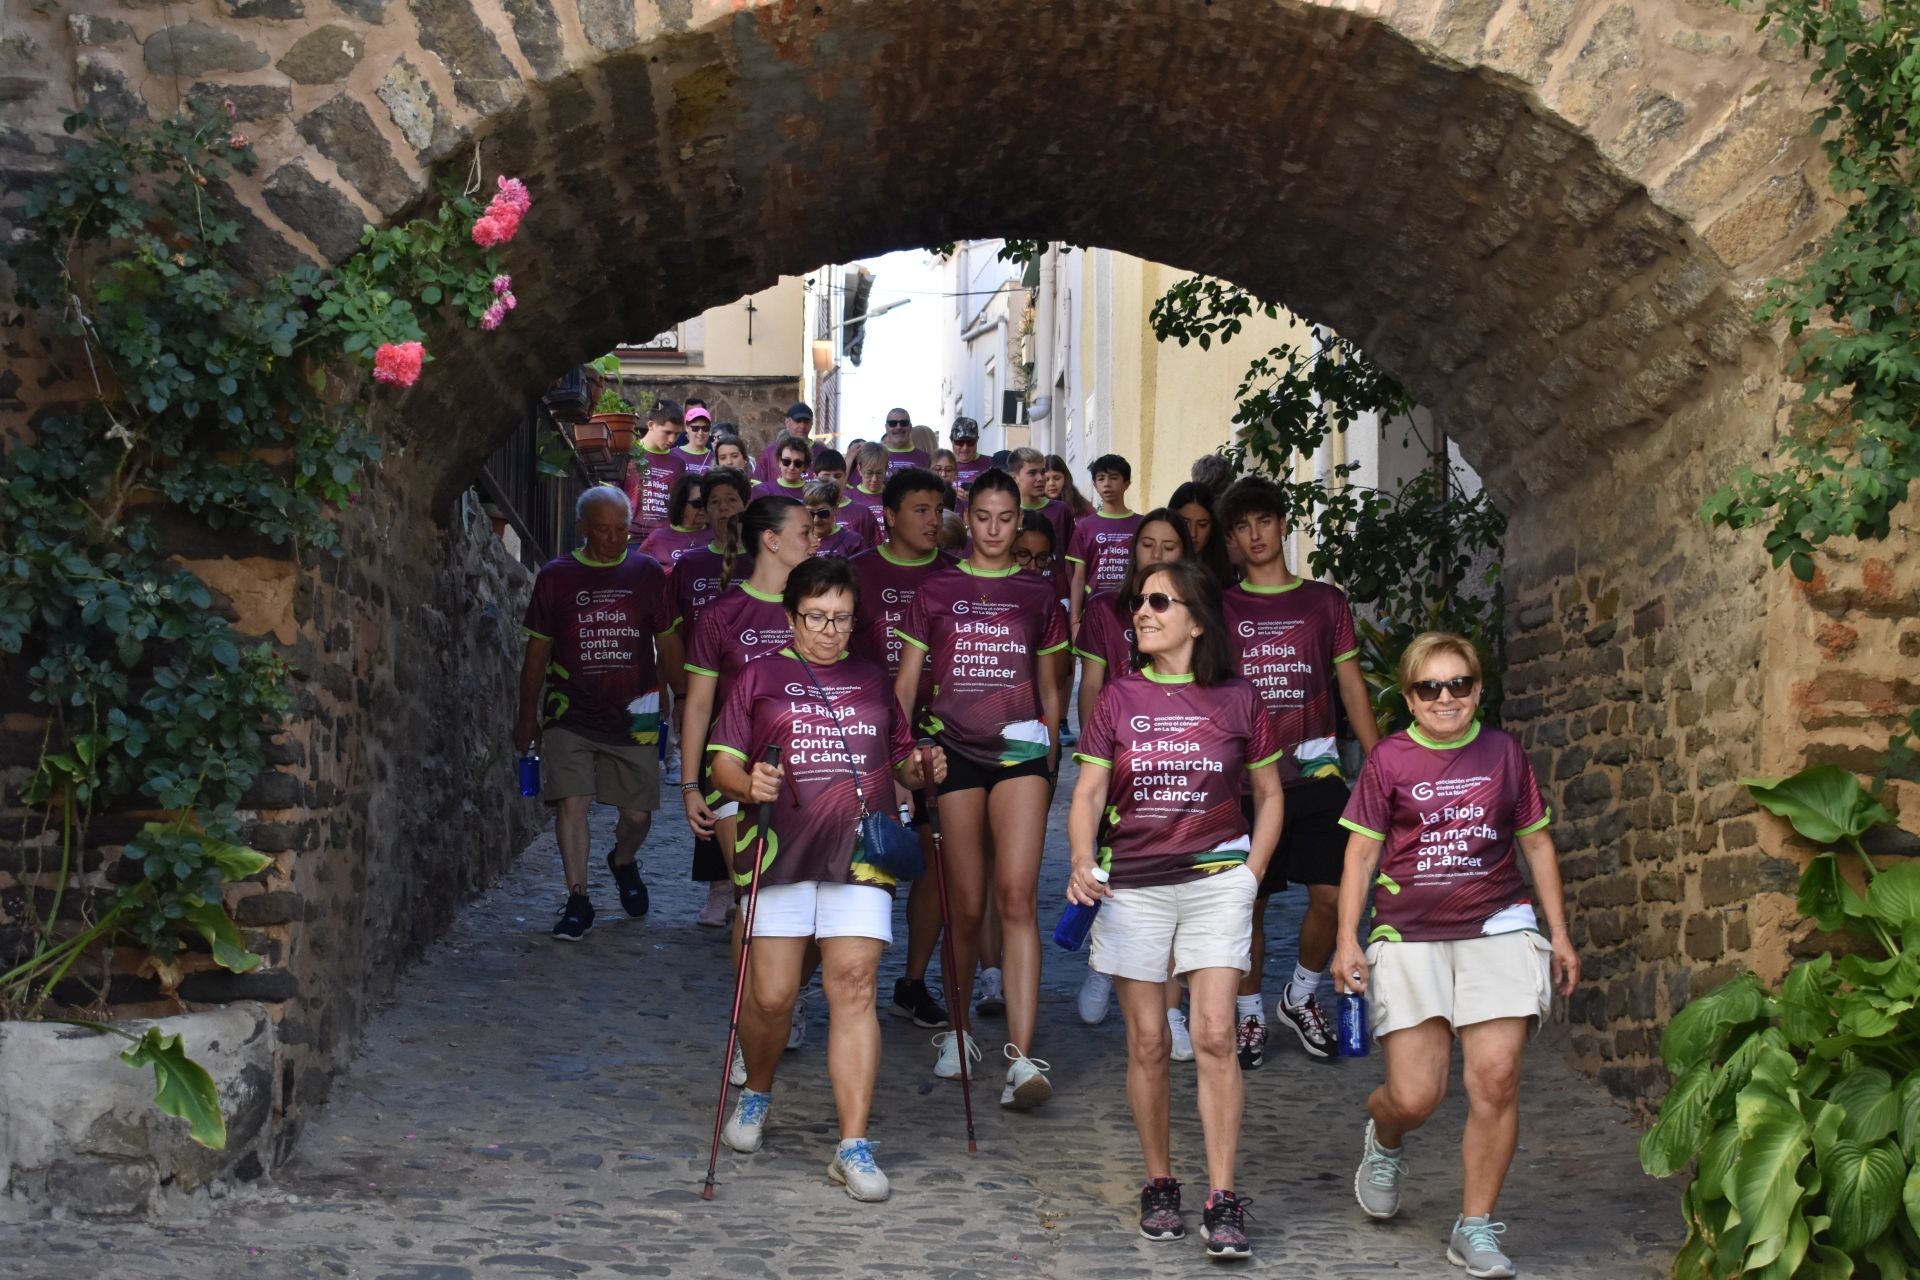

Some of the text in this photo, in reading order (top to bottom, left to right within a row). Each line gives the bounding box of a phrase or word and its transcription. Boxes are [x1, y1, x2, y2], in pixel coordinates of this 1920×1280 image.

[578, 610, 626, 623] La Rioja
[885, 610, 900, 621] La
[580, 627, 639, 638] En marcha
[955, 622, 1009, 637] La Rioja
[580, 638, 618, 649] contra
[955, 639, 1026, 654] En marcha
[581, 650, 632, 661] el cáncer
[887, 651, 899, 661] el
[1243, 644, 1296, 658] La Rioja
[954, 653, 998, 665] contra
[953, 665, 1016, 678] el cáncer
[1244, 661, 1312, 675] En marcha
[1252, 675, 1287, 686] ontra
[1260, 688, 1304, 700] cáncer
[791, 702, 855, 720] La Rioja
[792, 720, 876, 736] En marcha
[791, 738, 845, 749] contra
[1132, 740, 1200, 754] La Rioja
[790, 751, 866, 764] el cáncer
[1131, 757, 1222, 772] En marcha
[1133, 773, 1187, 786] contra
[1134, 787, 1208, 802] el cáncer
[1419, 803, 1484, 825] La Rioja
[1420, 824, 1497, 843] En marcha
[1417, 857, 1431, 871] el
